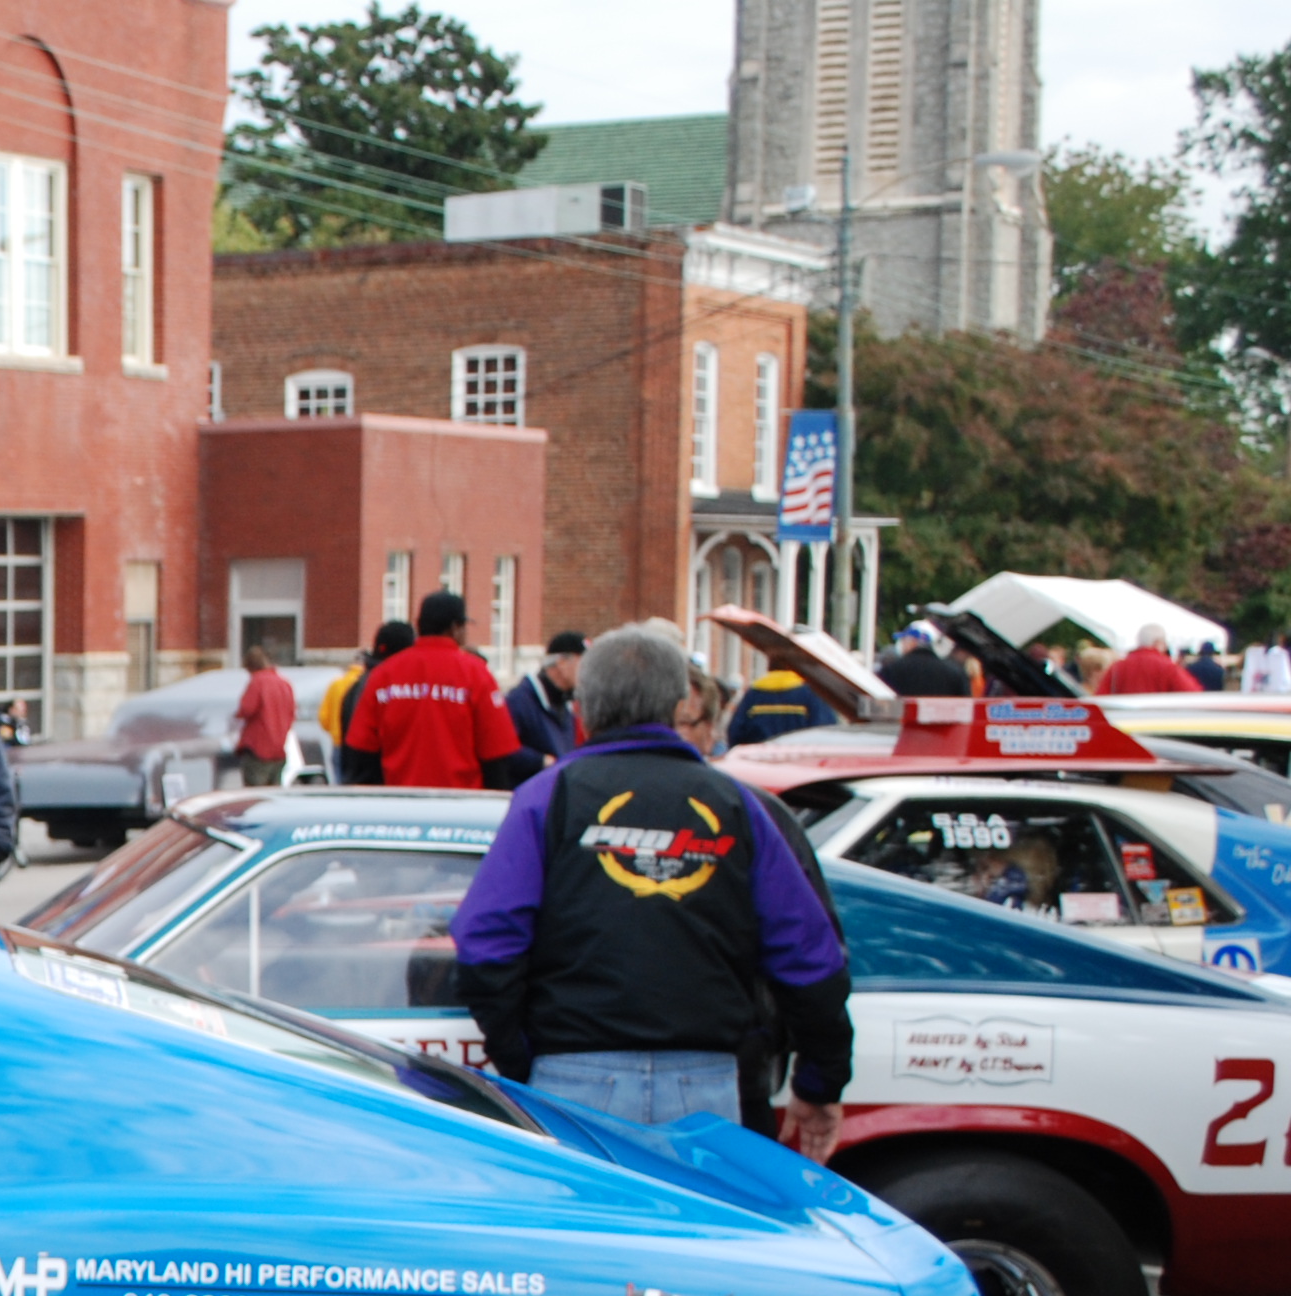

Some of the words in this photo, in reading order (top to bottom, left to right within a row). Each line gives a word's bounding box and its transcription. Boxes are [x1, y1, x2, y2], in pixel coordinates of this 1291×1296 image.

[351, 825, 422, 841] SPRING
[1200, 1056, 1291, 1168] 2
[75, 1257, 219, 1285] MARYLAND
[225, 1262, 253, 1286] HI
[257, 1262, 457, 1293] PERFORMANCE
[461, 1270, 546, 1296] SALES
